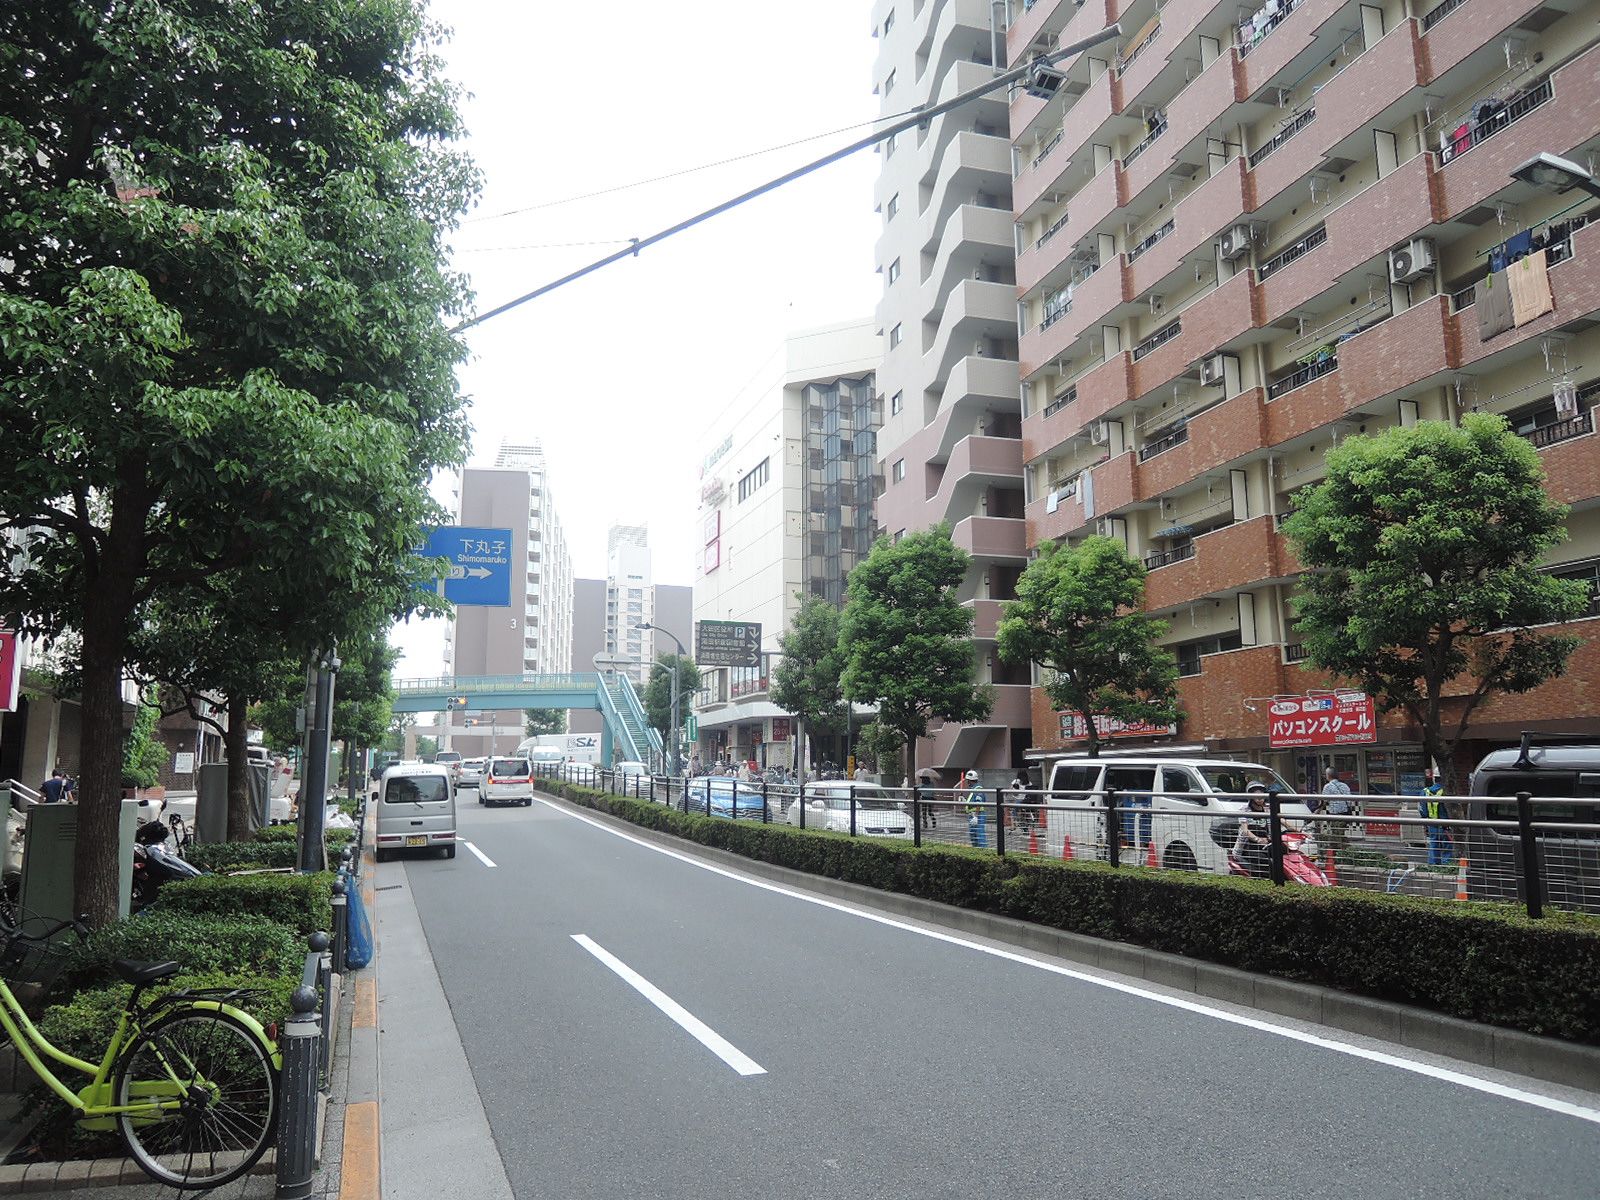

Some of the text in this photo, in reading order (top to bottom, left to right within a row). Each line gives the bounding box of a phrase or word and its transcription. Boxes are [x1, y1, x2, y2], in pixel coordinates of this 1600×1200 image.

[459, 538, 506, 554] 下丸子
[457, 553, 508, 564] Shimomaruko
[510, 618, 517, 629] 3
[1272, 713, 1371, 737] パソコンスクール
